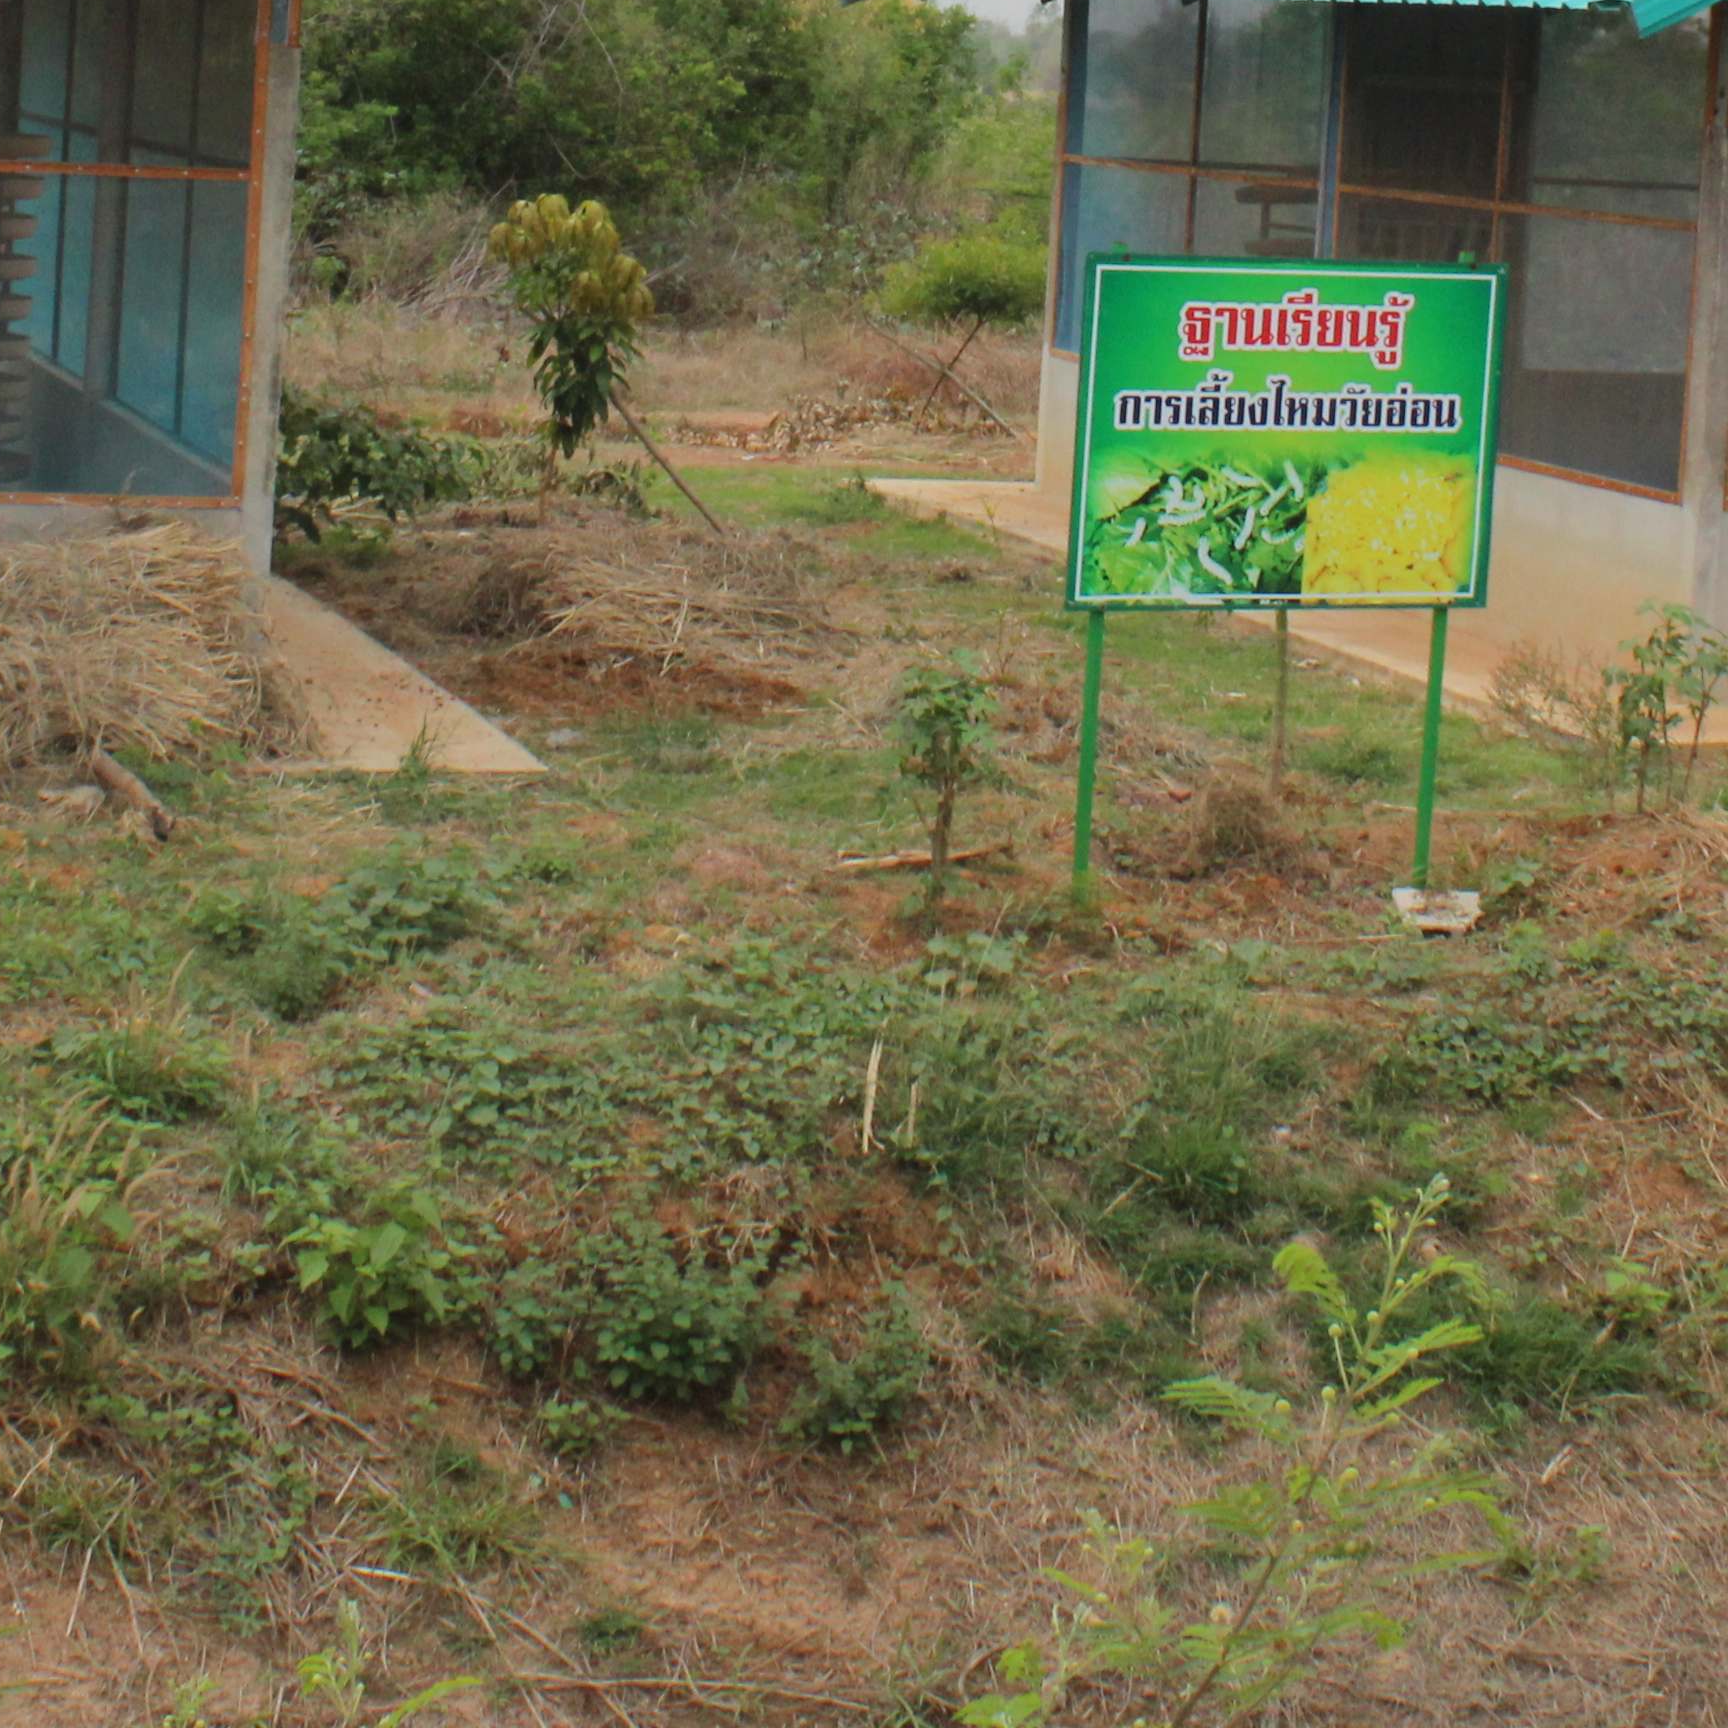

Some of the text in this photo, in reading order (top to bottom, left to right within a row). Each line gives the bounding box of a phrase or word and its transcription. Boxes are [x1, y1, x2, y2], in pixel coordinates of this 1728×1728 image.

[1181, 291, 1413, 366] ฐานเรียนรู้
[1117, 371, 1461, 429] การเลี้ยงไหมวัยอ่อน
